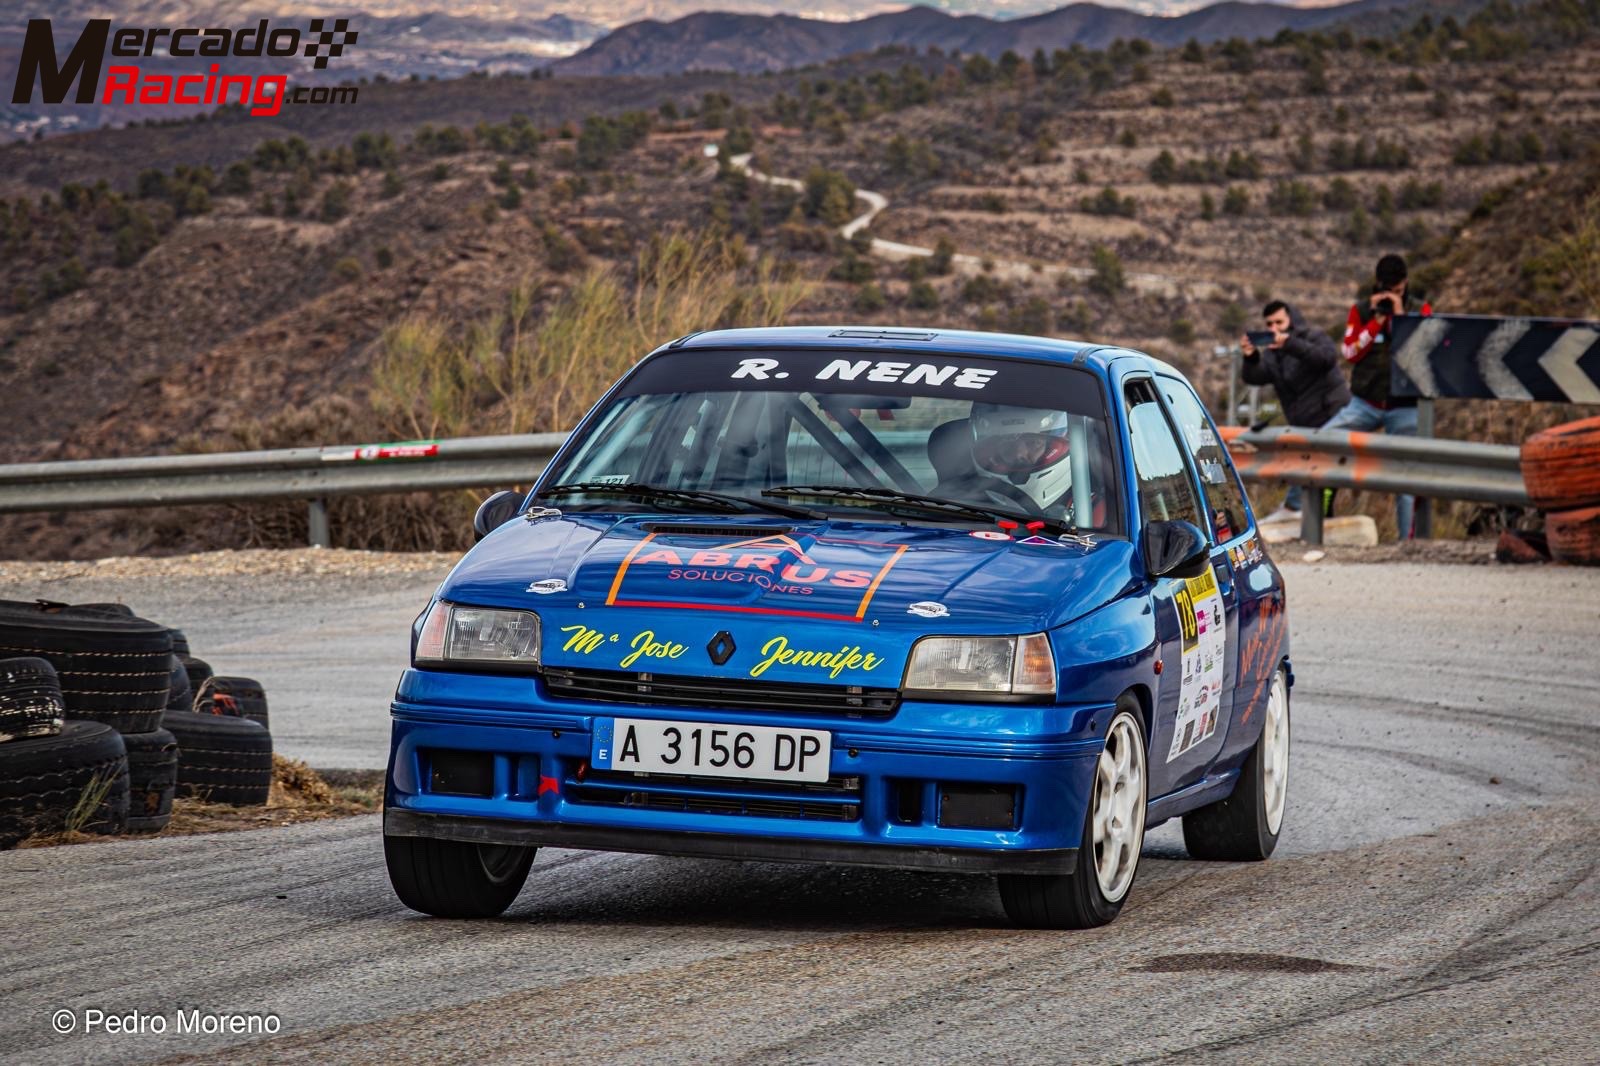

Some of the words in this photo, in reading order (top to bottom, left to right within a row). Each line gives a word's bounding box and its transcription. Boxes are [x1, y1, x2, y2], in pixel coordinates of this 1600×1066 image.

[731, 358, 789, 380] R.
[815, 359, 998, 389] NENE
[632, 550, 872, 588] ABRUS
[667, 568, 813, 595] SOLUCIONES
[1176, 590, 1196, 640] 78
[620, 630, 689, 668] Jose
[750, 636, 884, 679] Jennifer
[599, 750, 607, 759] E
[619, 725, 640, 762] A
[660, 727, 755, 768] 3156
[774, 734, 821, 772] DP
